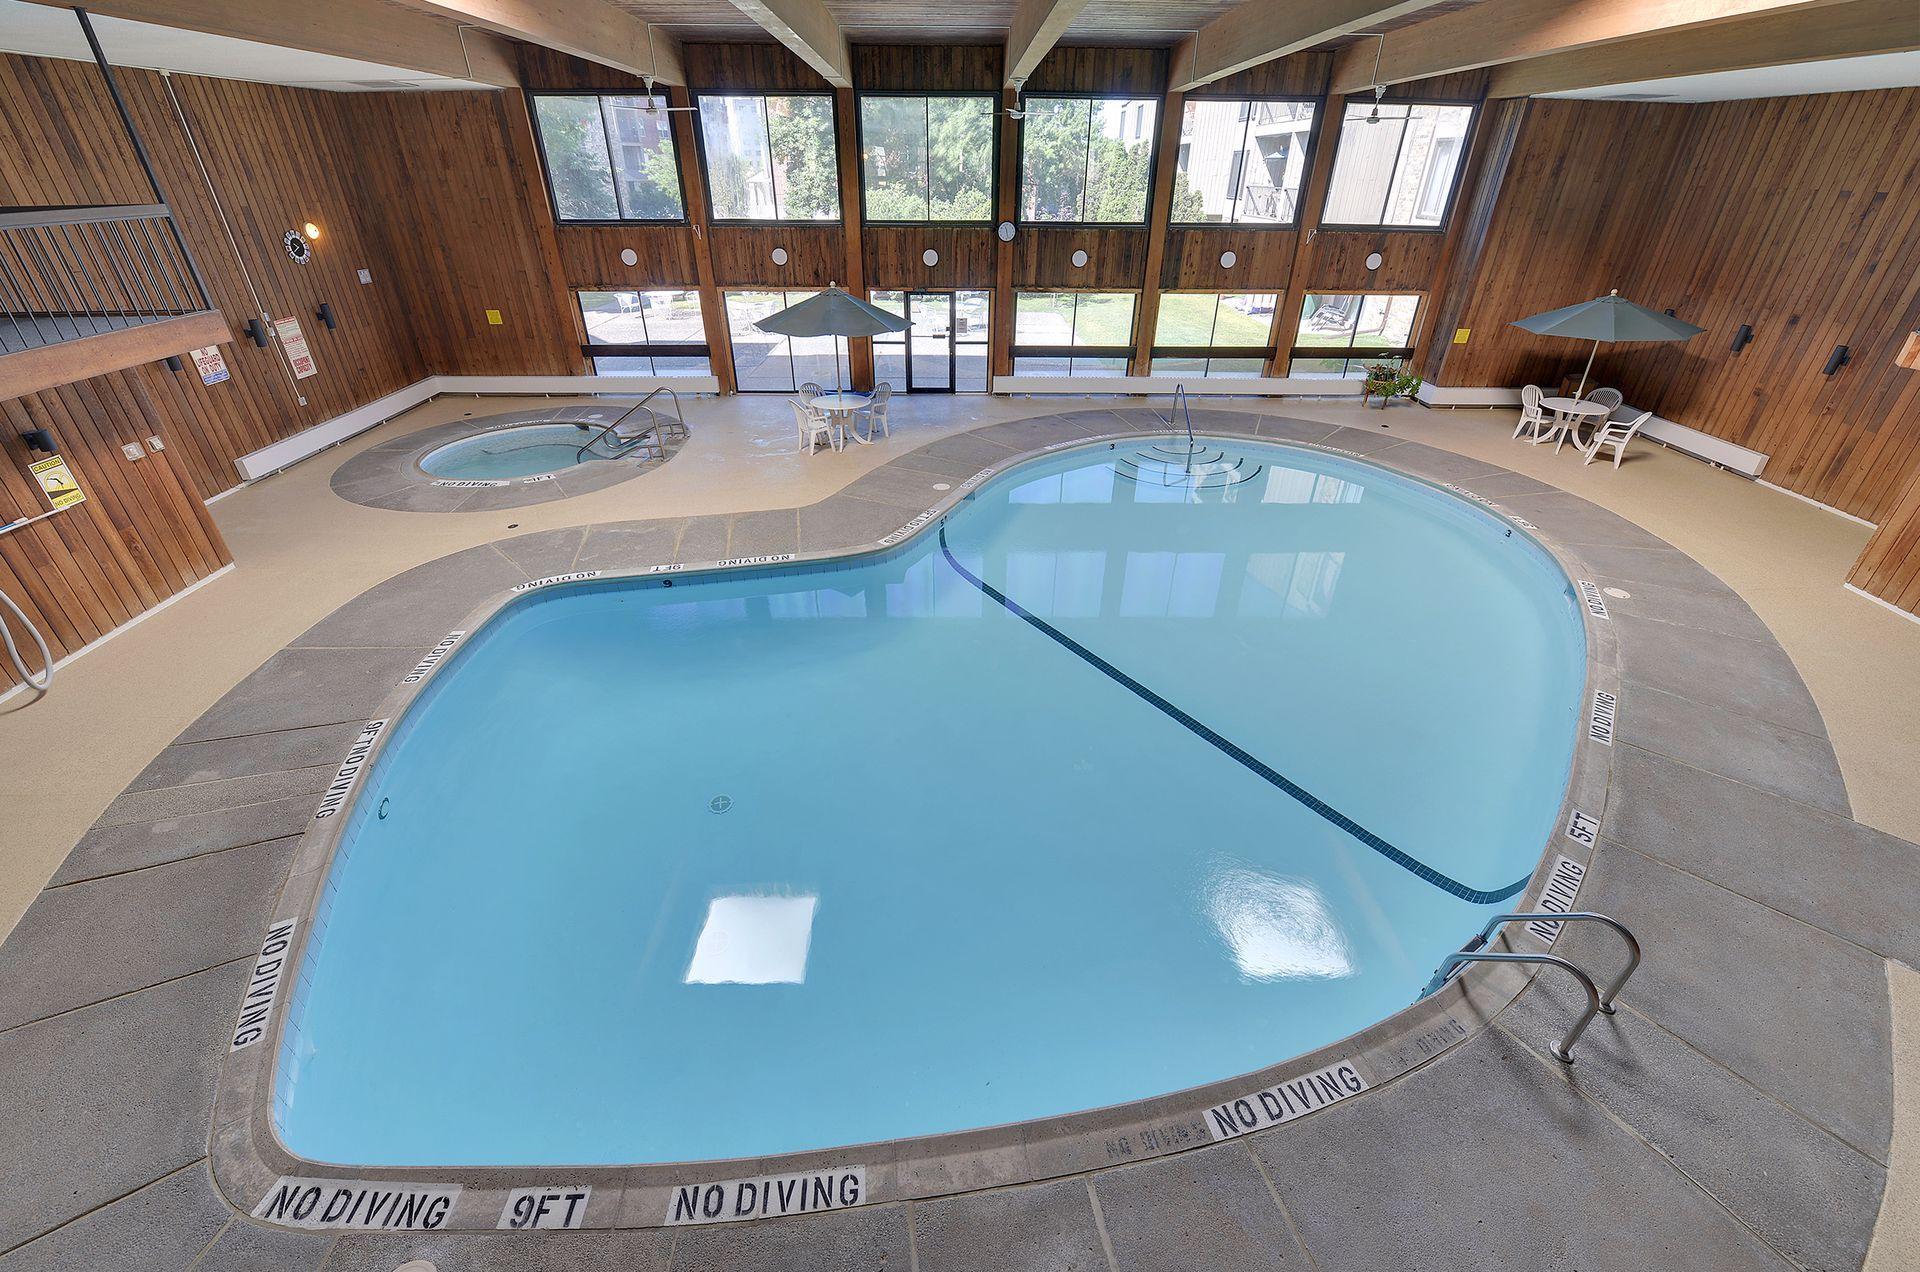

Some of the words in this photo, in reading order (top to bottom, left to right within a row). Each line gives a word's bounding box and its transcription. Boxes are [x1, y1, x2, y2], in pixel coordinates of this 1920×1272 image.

[195, 353, 220, 367] LIFEGUARD
[200, 346, 208, 356] NO
[33, 458, 61, 471] CAUTION
[64, 491, 82, 503] DIVING
[718, 557, 768, 567] DIVING
[770, 554, 790, 562] NO
[516, 576, 571, 590] DIVING
[576, 571, 597, 579] NO
[440, 634, 462, 646] NO
[404, 648, 448, 683] DIVING
[1593, 691, 1616, 724] DIVING
[354, 721, 384, 745] 9FT
[1590, 721, 1610, 743] NO
[345, 745, 371, 765] NO
[315, 766, 359, 819] DIVING
[1569, 812, 1598, 843] 5FT
[1541, 861, 1584, 914] DIVING
[265, 924, 294, 956] NO
[233, 958, 283, 1046] DIVING
[1211, 1099, 1259, 1137] NO
[1258, 1065, 1363, 1122] DIVING
[265, 1185, 321, 1220] NO
[320, 1189, 451, 1229] DIVING
[674, 1184, 725, 1222] NO
[736, 1173, 860, 1217] DIVING
[509, 1194, 585, 1228] 9FT
